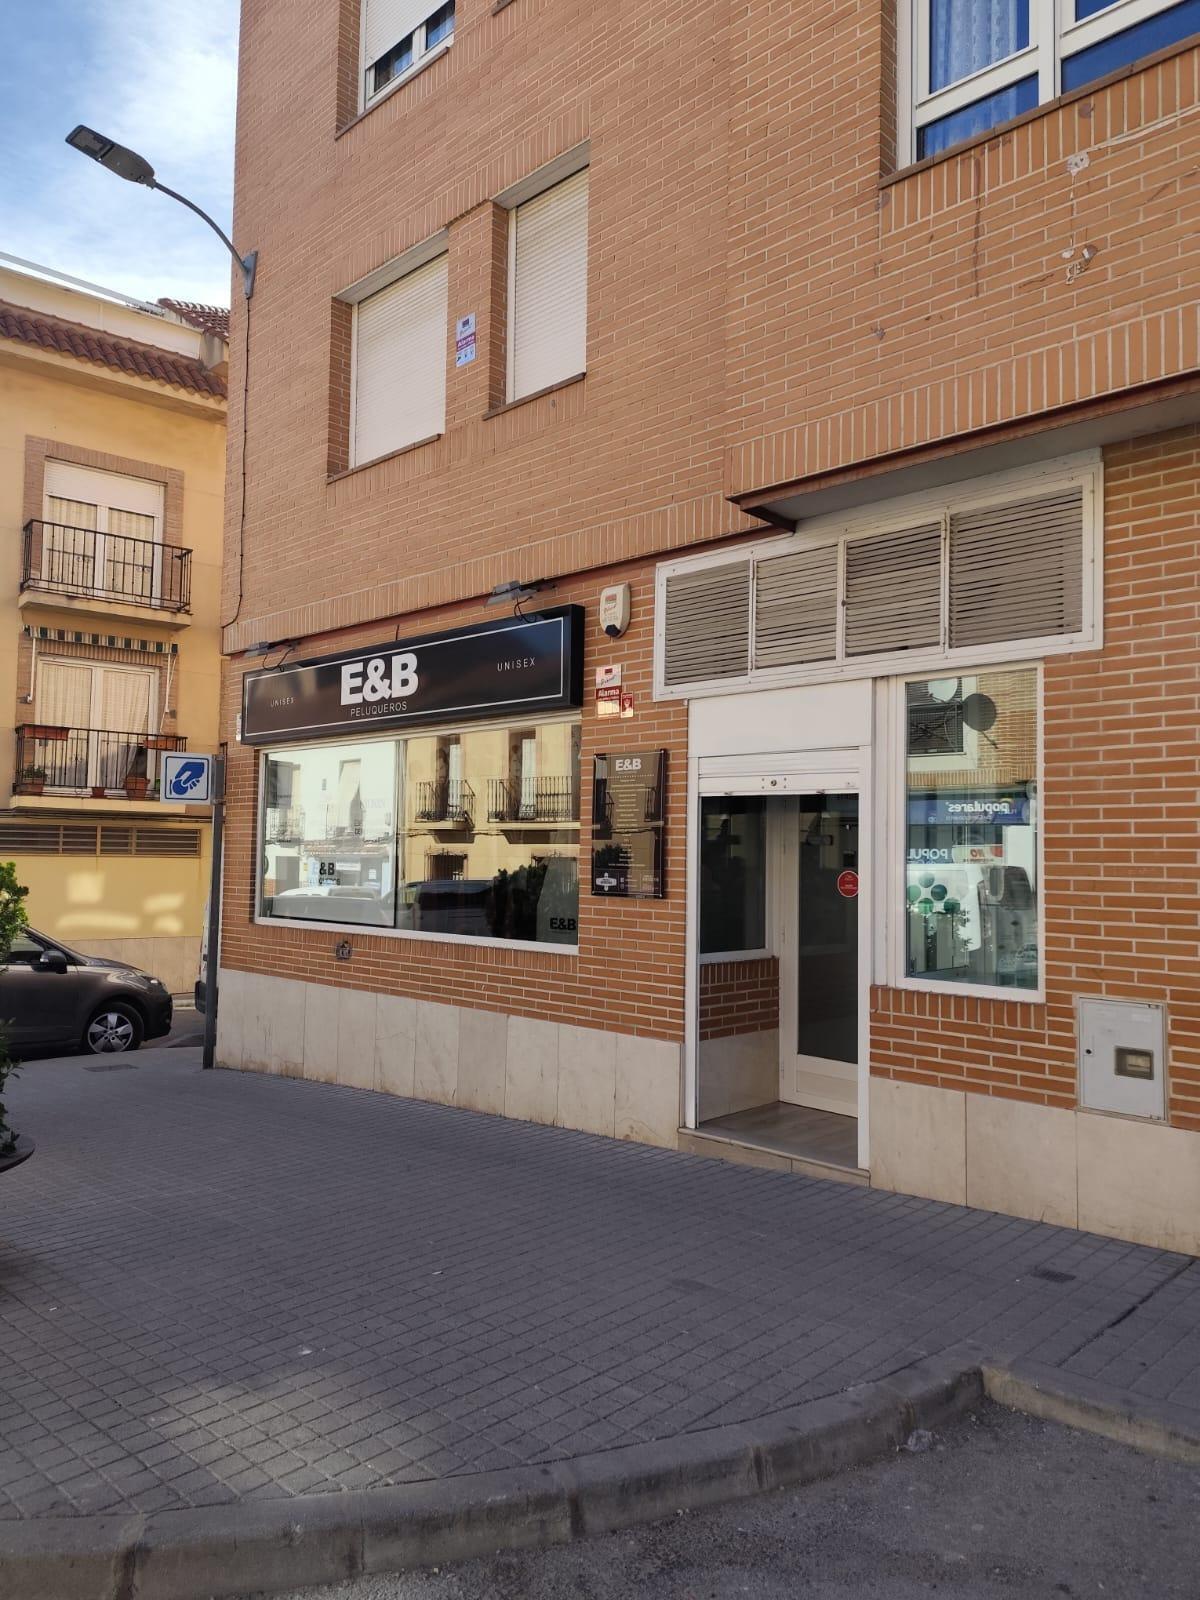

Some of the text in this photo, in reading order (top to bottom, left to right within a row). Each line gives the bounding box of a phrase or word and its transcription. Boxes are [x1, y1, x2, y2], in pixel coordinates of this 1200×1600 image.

[497, 656, 536, 672] UNISEX
[340, 652, 419, 706] E&B
[350, 701, 408, 717] PELUQUEROS
[615, 758, 642, 771] E&B
[550, 917, 577, 931] E&B
